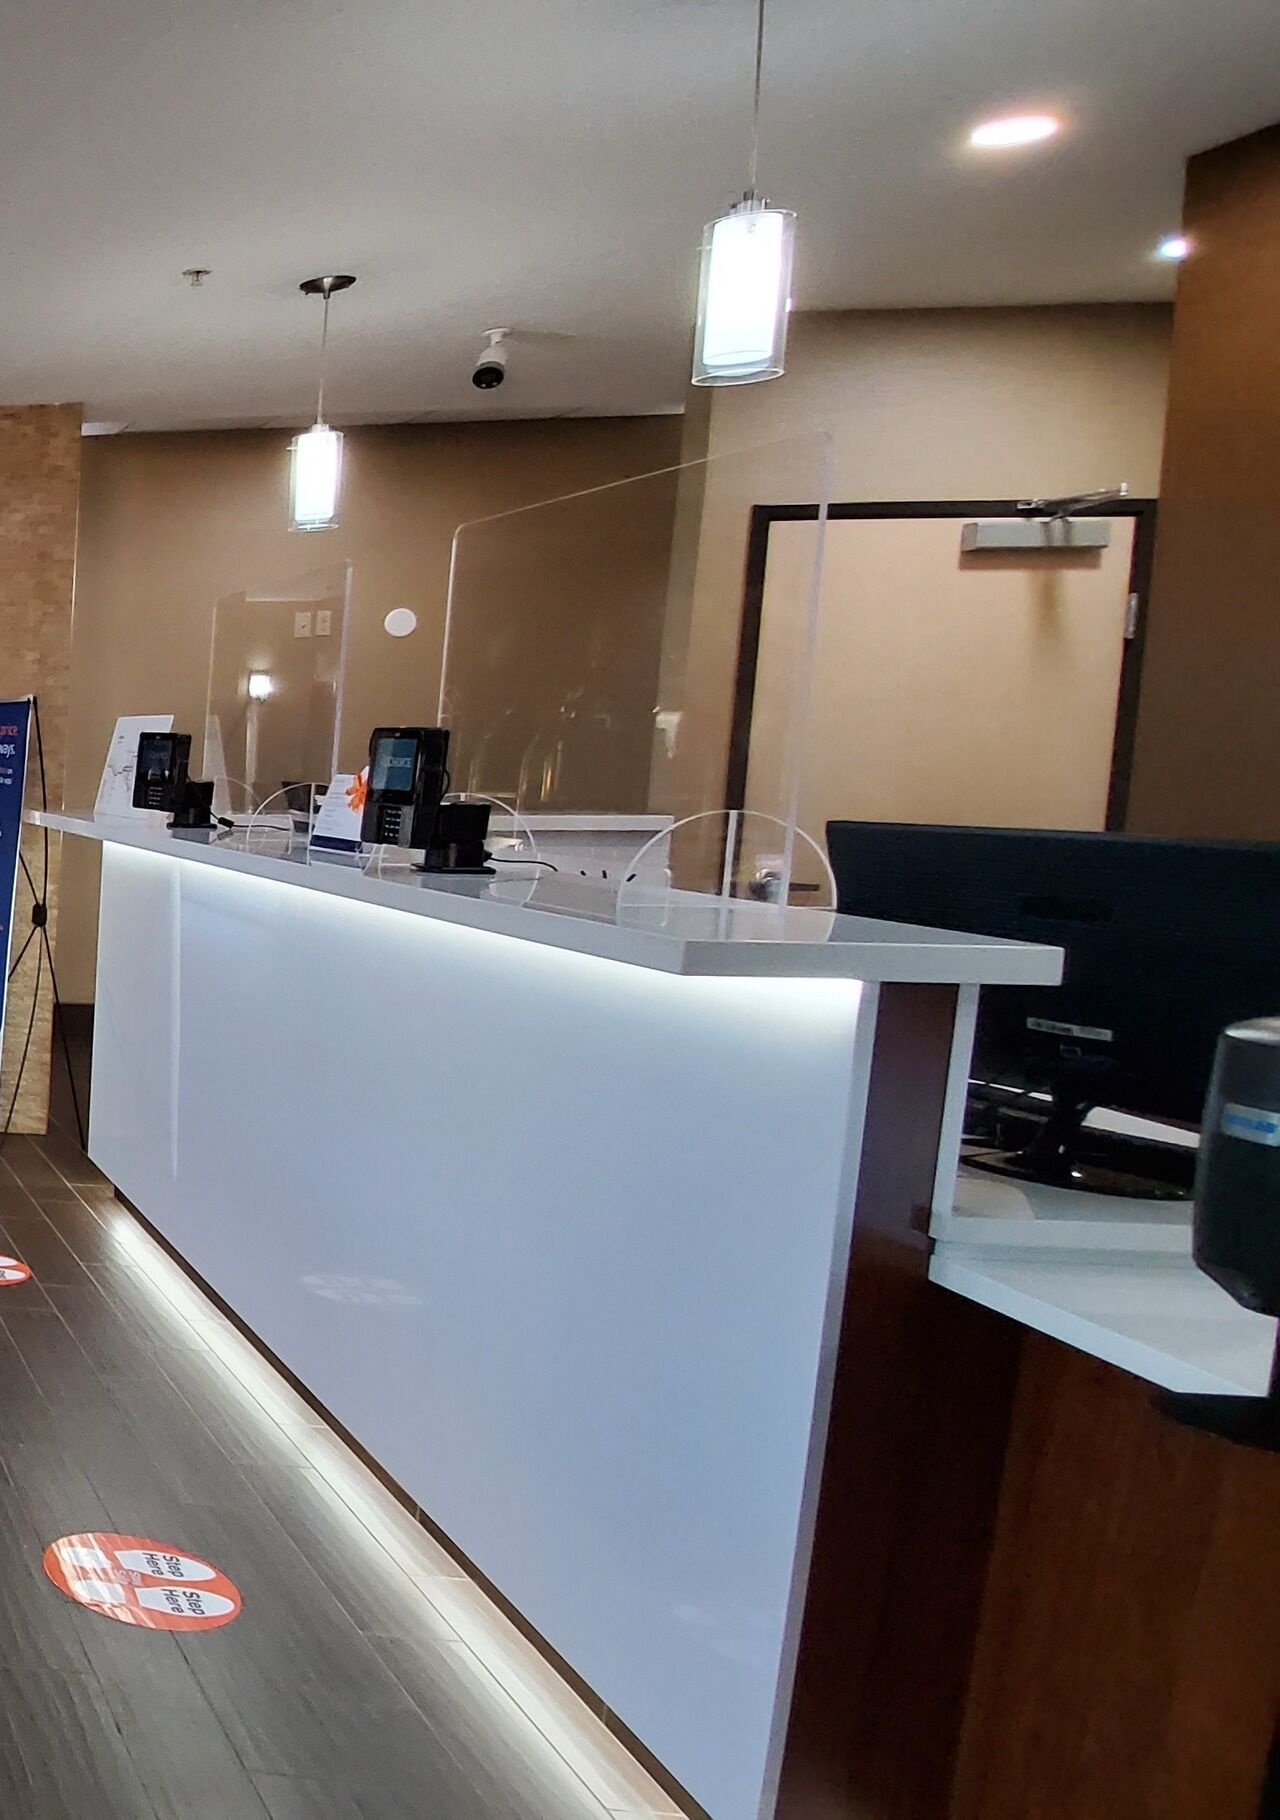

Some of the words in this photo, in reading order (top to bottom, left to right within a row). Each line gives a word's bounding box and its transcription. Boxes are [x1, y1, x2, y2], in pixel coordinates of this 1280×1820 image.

[142, 1552, 164, 1576] Here
[162, 1555, 185, 1578] Step
[161, 1588, 185, 1614] Here
[182, 1591, 206, 1616] Step
